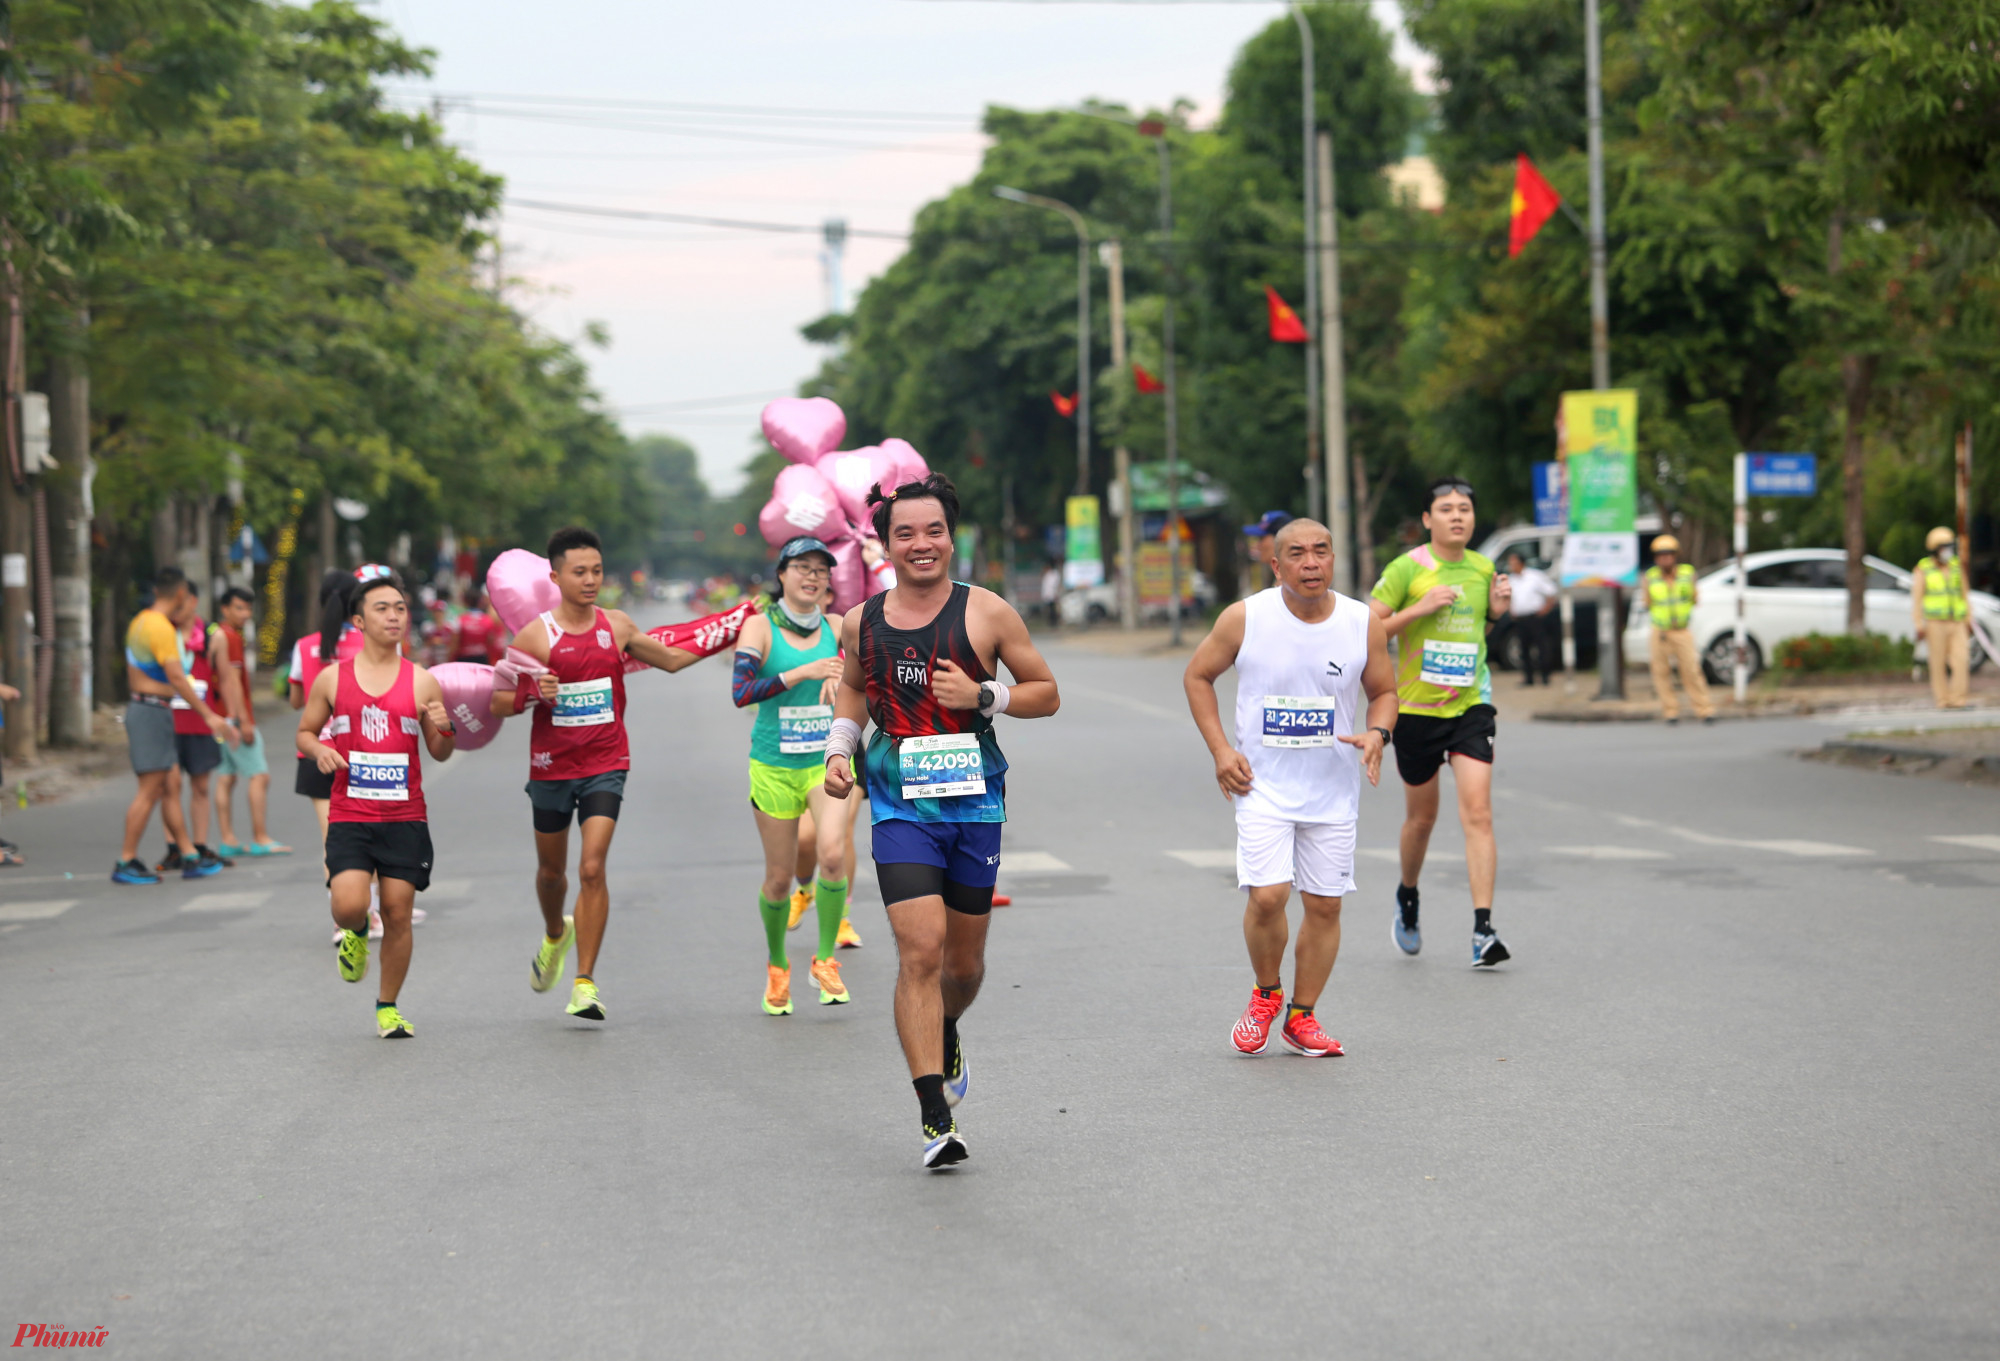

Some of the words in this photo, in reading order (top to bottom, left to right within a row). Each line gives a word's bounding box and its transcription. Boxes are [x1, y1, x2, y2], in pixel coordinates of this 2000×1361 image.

[1434, 655, 1474, 668] 42243
[897, 665, 927, 685] FAM
[565, 692, 605, 708] 42132
[1266, 710, 1276, 718] 21
[1278, 711, 1329, 727] 21423
[792, 718, 831, 733] 42081
[903, 755, 913, 763] 42
[918, 752, 981, 771] 42090
[361, 766, 405, 781] 21603
